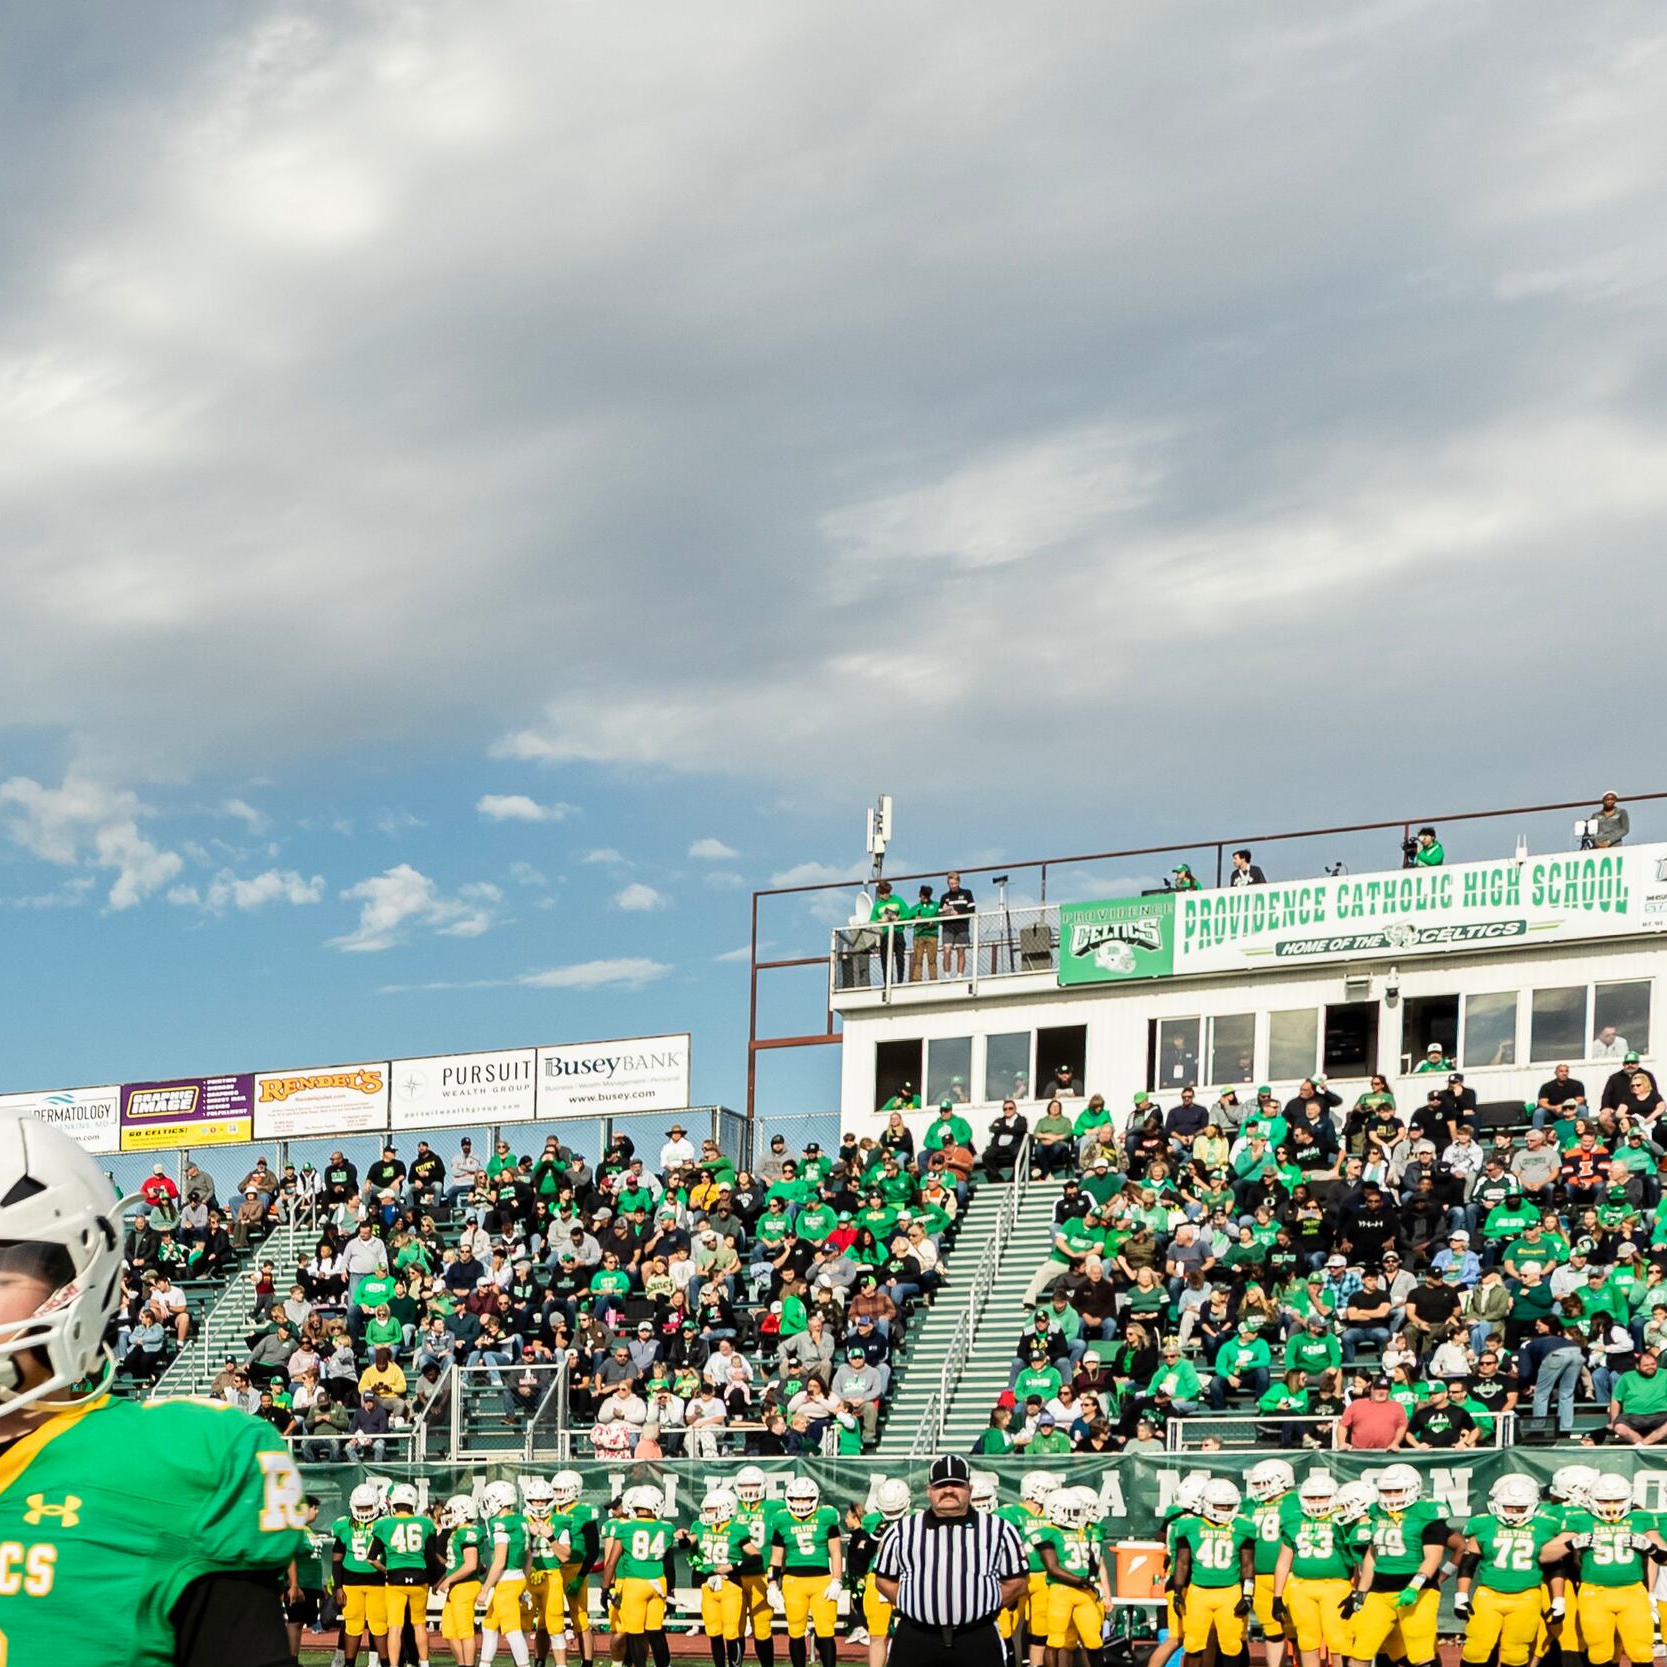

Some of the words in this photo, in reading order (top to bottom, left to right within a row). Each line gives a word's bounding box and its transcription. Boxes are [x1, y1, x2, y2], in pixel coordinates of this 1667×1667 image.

[1062, 903, 1174, 924] PROVIDENCE
[1184, 887, 1326, 954] PROVIDENCE
[1337, 873, 1452, 919] CATHOLIC
[1463, 866, 1521, 908] HIGH
[1532, 856, 1629, 914] SCHOOL
[1069, 917, 1164, 954] CELTICS
[1282, 940, 1327, 955] HOME
[1330, 938, 1352, 951] OF
[1353, 935, 1382, 948] THE
[1417, 921, 1520, 944] CELTICS
[259, 1069, 384, 1102] RENDEL'S
[442, 1060, 532, 1087] PURSUIT
[131, 1098, 192, 1114] IMAGE
[133, 1090, 195, 1104] GRAPHIC
[442, 1087, 487, 1098] WEALTH
[492, 1084, 531, 1094] GROUP
[568, 1089, 656, 1104] www.busey.com
[390, 1523, 423, 1554] 46
[632, 1530, 666, 1561] 84
[796, 1533, 816, 1556] 5
[1196, 1538, 1234, 1569] 40
[1492, 1537, 1535, 1570] 72
